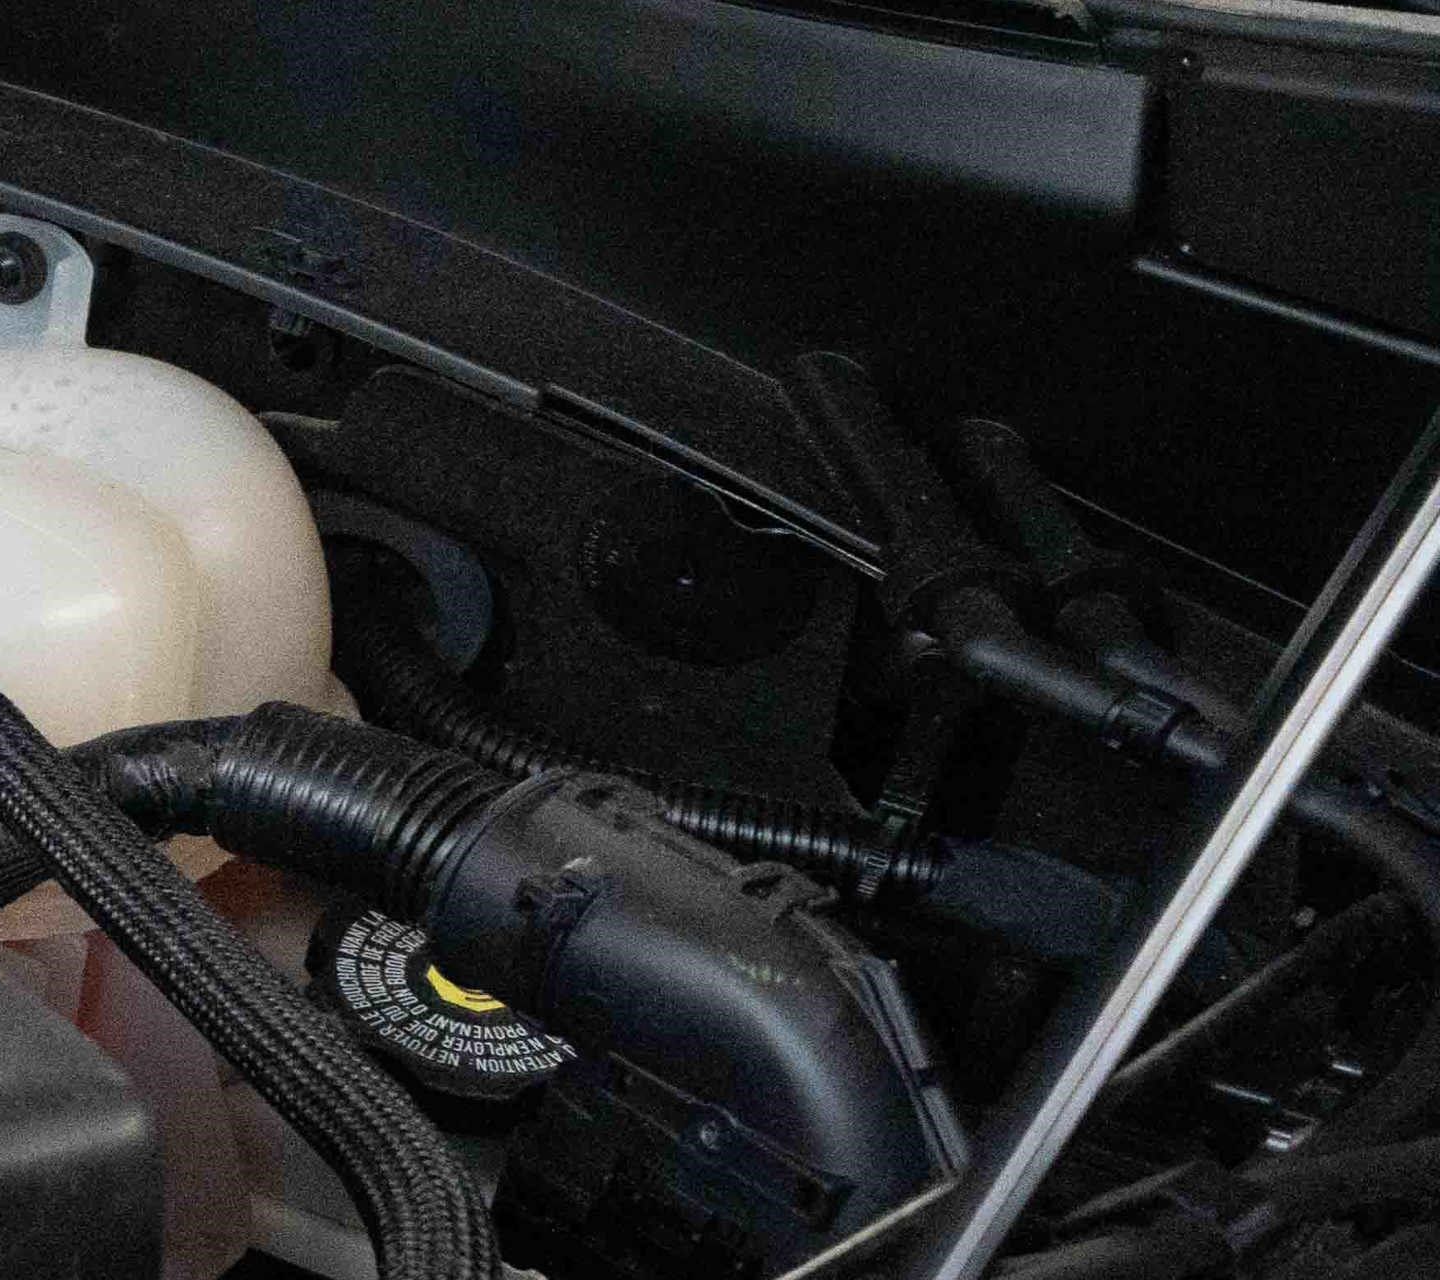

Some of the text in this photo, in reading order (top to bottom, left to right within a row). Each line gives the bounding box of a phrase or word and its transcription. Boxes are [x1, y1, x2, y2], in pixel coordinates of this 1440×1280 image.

[361, 910, 388, 926] LA
[338, 921, 371, 957] AVANT
[361, 944, 384, 961] DE
[384, 951, 408, 985] BIDON
[336, 957, 371, 1010] BOUCHON
[360, 961, 393, 1004] LIQUIDE
[359, 1011, 386, 1027] LE
[380, 1005, 409, 1022] DU
[425, 1013, 528, 1040] PROVENANT
[402, 1020, 439, 1042] QUE
[379, 1023, 460, 1067] NETTOYER
